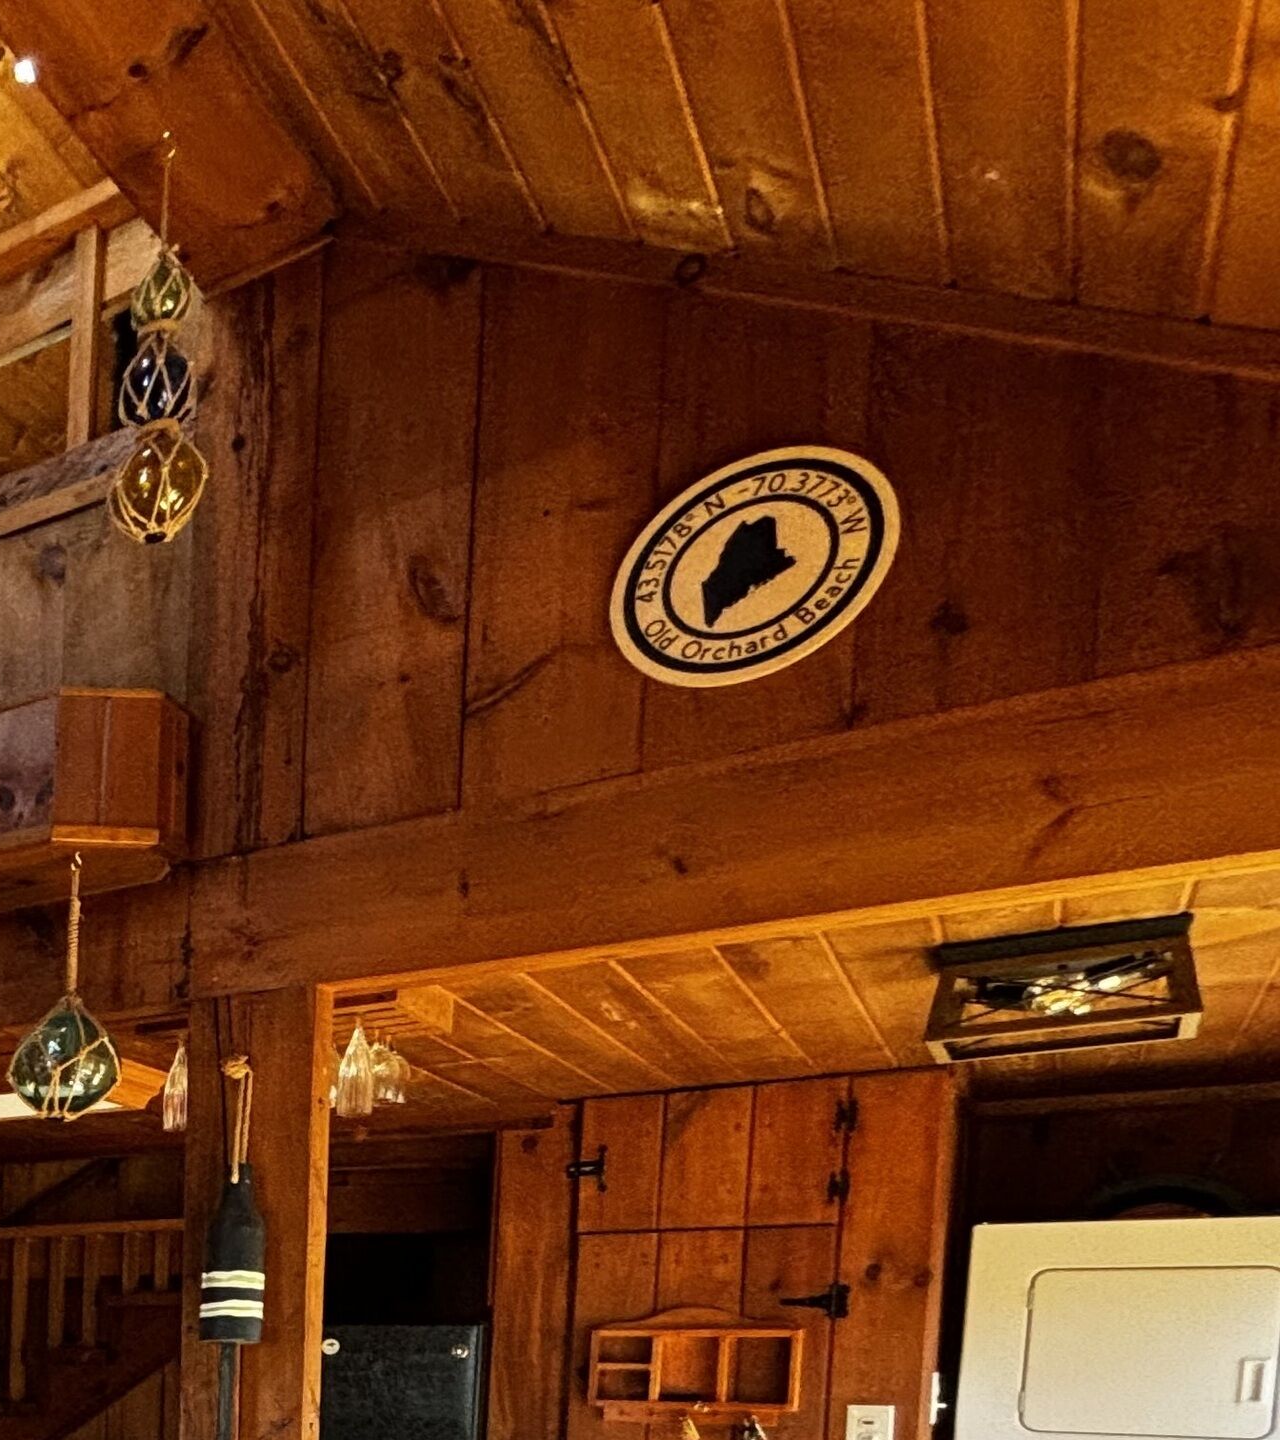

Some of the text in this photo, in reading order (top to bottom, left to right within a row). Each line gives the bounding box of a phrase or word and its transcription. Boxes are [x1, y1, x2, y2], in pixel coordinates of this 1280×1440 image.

[703, 493, 726, 517] N
[840, 507, 868, 535] W
[644, 556, 860, 661] Old Orchard Beach
